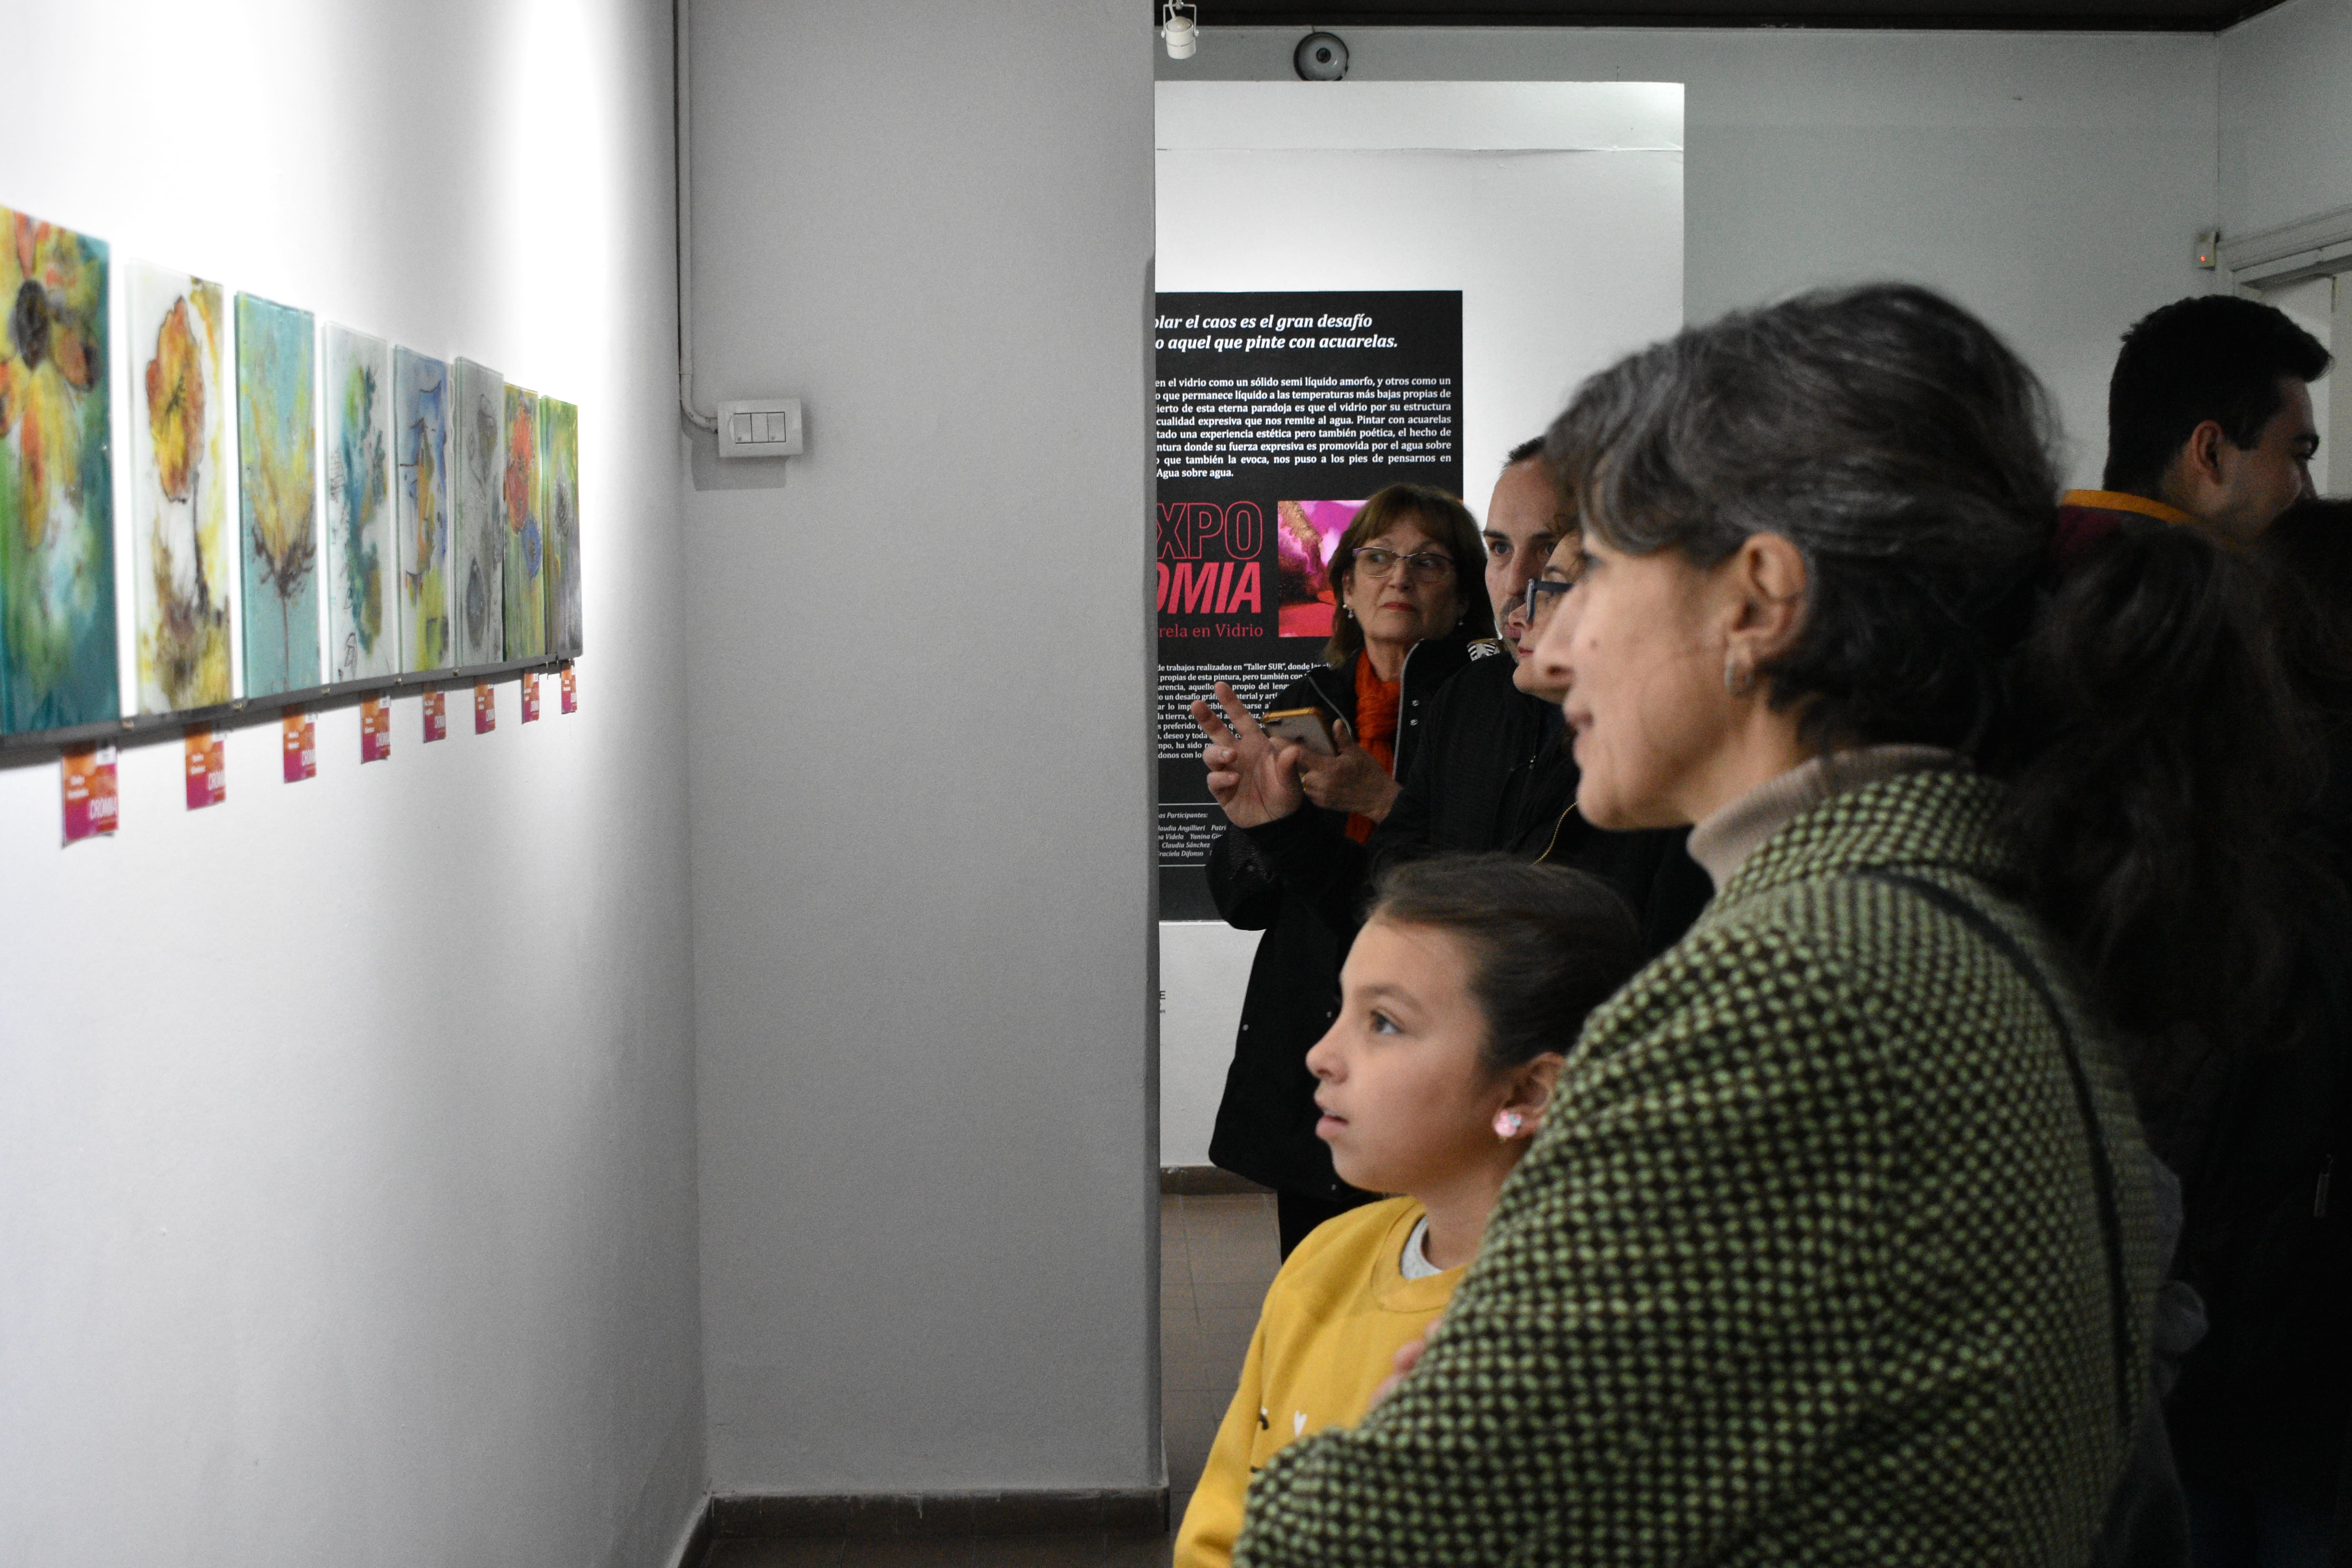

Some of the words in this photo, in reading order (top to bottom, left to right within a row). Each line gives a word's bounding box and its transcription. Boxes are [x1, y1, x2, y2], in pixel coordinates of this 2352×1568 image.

[1185, 314, 1200, 328] el
[1202, 318, 1237, 328] caos
[1240, 317, 1257, 328] es
[1259, 314, 1274, 328] el
[1275, 317, 1314, 331] gran
[1317, 313, 1372, 331] desafío
[1155, 338, 1164, 349] o
[1167, 334, 1211, 352] aquel
[1214, 338, 1243, 352] que
[1245, 334, 1286, 352] pinte
[1288, 337, 1316, 348] con
[1319, 334, 1397, 348] acuarelas.
[1168, 377, 1176, 387] el
[1178, 377, 1207, 387] vidrio
[1250, 376, 1279, 387] sólido
[1280, 377, 1303, 386] semi
[1305, 376, 1338, 388] líquido
[1339, 376, 1375, 387] amorfo,
[1377, 378, 1383, 388] y
[1385, 377, 1409, 385] otros
[1162, 392, 1180, 402] que
[1181, 392, 1233, 402] permanece
[1234, 389, 1268, 402] líquido
[1276, 389, 1290, 399] las
[1291, 390, 1354, 401] temperaturas
[1356, 388, 1375, 399] más
[1377, 388, 1401, 400] bajas
[1403, 389, 1438, 400] propias
[1439, 388, 1451, 397] de
[1156, 404, 1179, 413] ierto
[1181, 403, 1193, 413] de
[1196, 404, 1215, 413] esta
[1218, 404, 1248, 412] eterna
[1251, 402, 1292, 414] paradoja
[1307, 404, 1325, 414] que
[1328, 401, 1336, 412] el
[1339, 401, 1367, 411] vidrio
[1370, 404, 1387, 414] por
[1403, 403, 1451, 411] estructura
[1156, 416, 1195, 426] cualidad
[1198, 416, 1242, 428] expresiva
[1244, 417, 1262, 427] que
[1284, 415, 1315, 425] remite
[1318, 415, 1326, 425] al
[1329, 417, 1354, 427] agua.
[1357, 415, 1385, 424] Pintar
[1407, 414, 1451, 424] acuarelas
[1156, 429, 1177, 439] tado
[1200, 428, 1254, 441] experiencia
[1256, 428, 1292, 438] estética
[1294, 430, 1316, 440] pero
[1318, 427, 1356, 437] también
[1359, 427, 1395, 439] poética,
[1397, 427, 1406, 437] el
[1409, 427, 1437, 437] hecho
[1439, 427, 1451, 436] de
[1156, 443, 1181, 452] ntura
[1183, 441, 1213, 452] donde
[1229, 441, 1258, 451] fuerza
[1260, 441, 1304, 453] expresiva
[1319, 440, 1369, 453] promovida
[1371, 442, 1388, 452] por
[1390, 440, 1399, 450] el
[1401, 442, 1423, 452] agua
[1425, 440, 1451, 449] sobre
[1163, 457, 1181, 466] que
[1185, 454, 1223, 464] también
[1228, 454, 1236, 464] la
[1240, 456, 1269, 465] evoca,
[1294, 456, 1317, 466] puso
[1331, 453, 1345, 463] los
[1348, 454, 1368, 465] pies
[1372, 453, 1383, 463] de
[1388, 455, 1436, 465] pensarnos
[1156, 468, 1180, 479] Agua
[1181, 467, 1208, 477] sobre
[1209, 469, 1234, 479] agua.
[1159, 624, 1187, 637] rela
[1192, 627, 1210, 637] en
[1216, 623, 1263, 637] Vidrio
[1166, 663, 1195, 672] trabajos
[1268, 662, 1287, 671] SUR”,
[1287, 662, 1310, 670] donde
[1160, 673, 1186, 682] propias
[1213, 673, 1241, 682] pintura,
[1259, 672, 1289, 680] también
[1188, 682, 1214, 692] aquello
[1232, 683, 1256, 691] propio
[1201, 692, 1219, 702] gráfi
[1163, 722, 1196, 731] preferido
[1166, 811, 1208, 820] Participantes:
